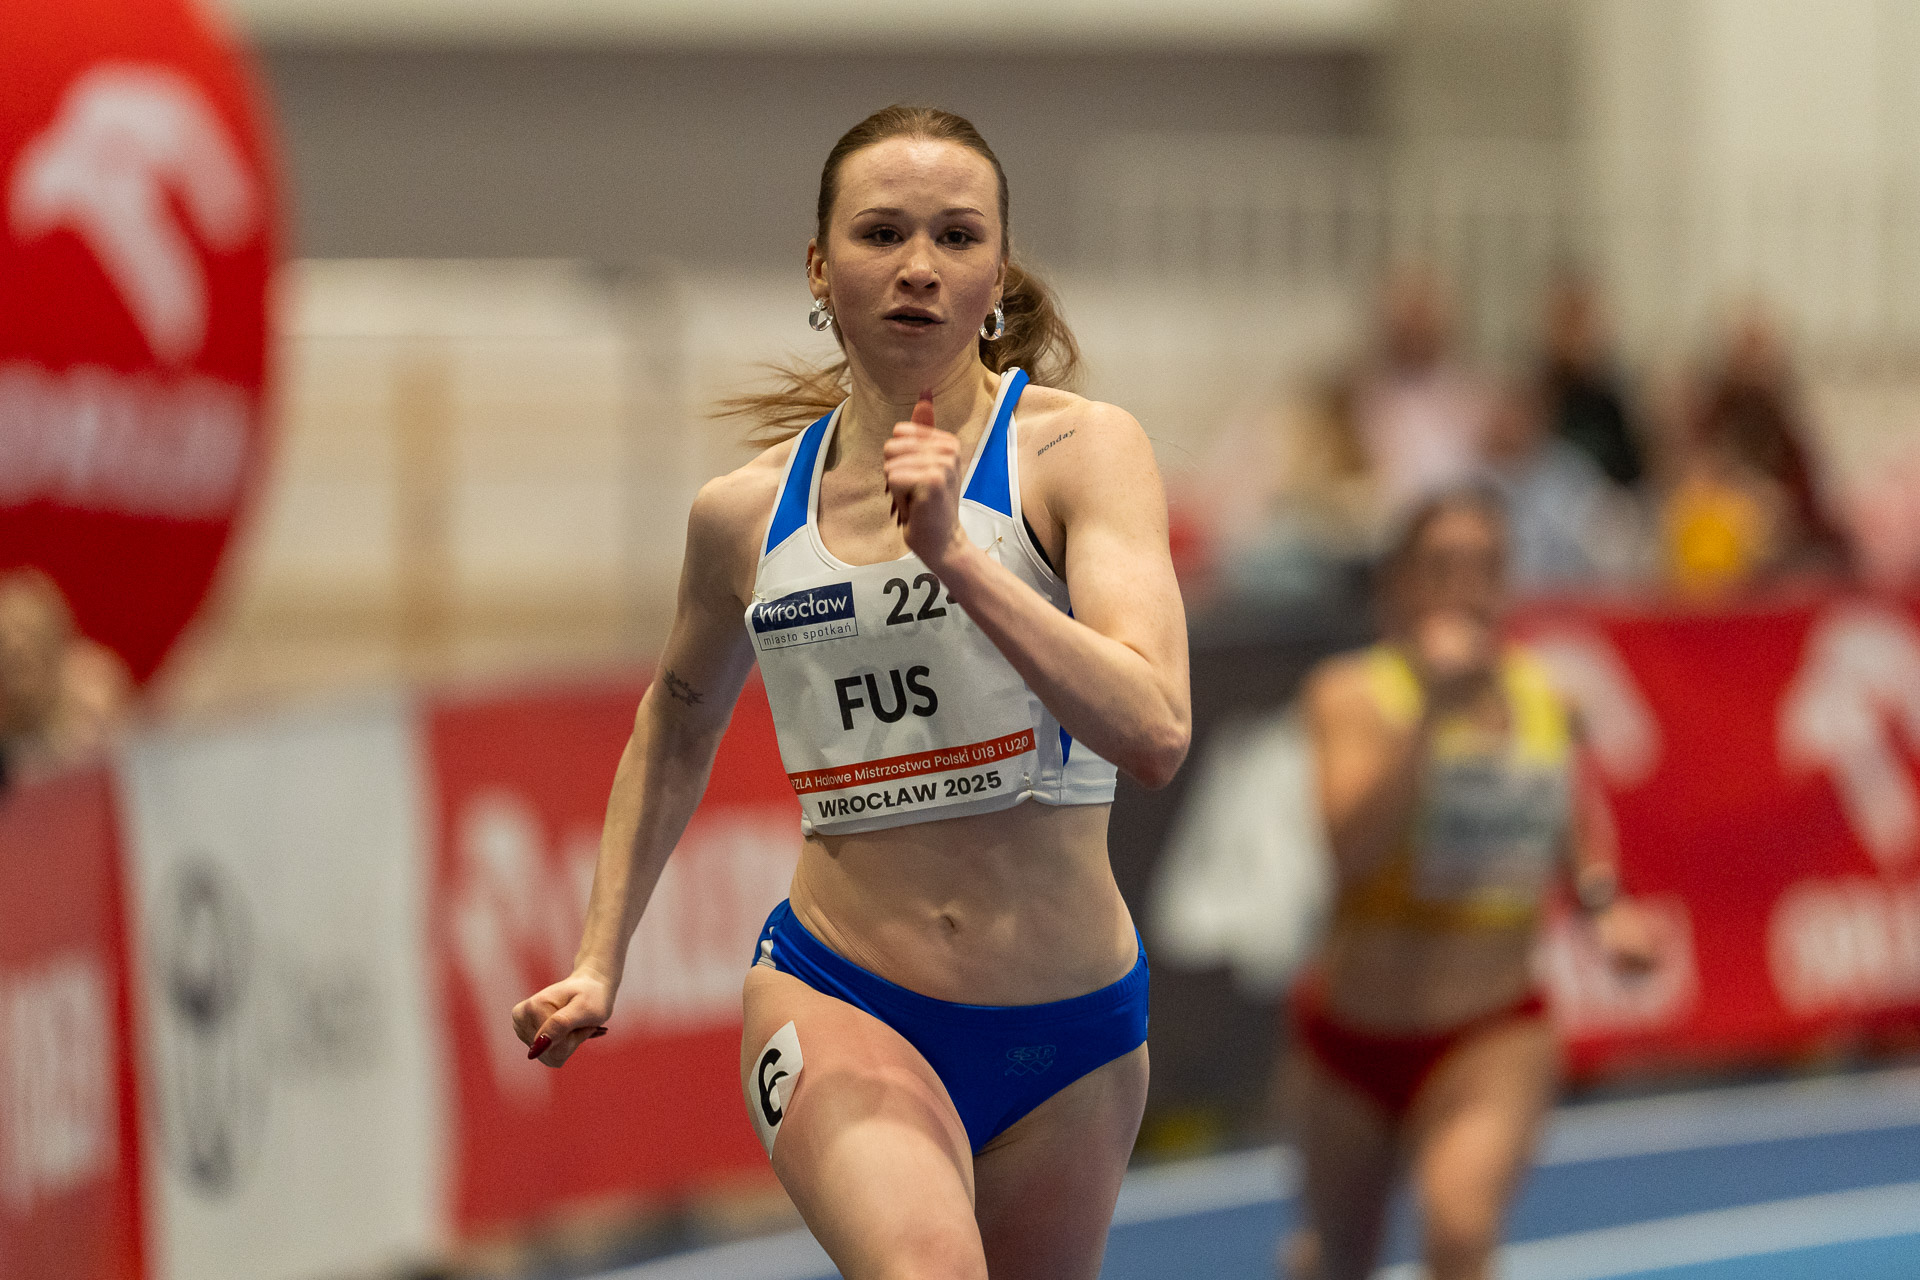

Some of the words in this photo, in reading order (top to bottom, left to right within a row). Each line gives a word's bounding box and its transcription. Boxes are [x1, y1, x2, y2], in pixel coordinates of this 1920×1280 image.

[1037, 429, 1075, 456] monday
[883, 573, 959, 625] 22
[764, 633, 797, 646] miasto
[803, 622, 852, 641] spotkań
[834, 666, 938, 730] FUS
[815, 773, 851, 787] Halowe
[855, 759, 931, 781] Mistrzostwa
[934, 751, 969, 767] Polski
[972, 746, 995, 760] U18
[998, 743, 1003, 754] i
[1005, 736, 1029, 752] U20
[818, 782, 937, 818] WROCŁAW
[944, 770, 1002, 797] 2025
[758, 1048, 789, 1127] 6
